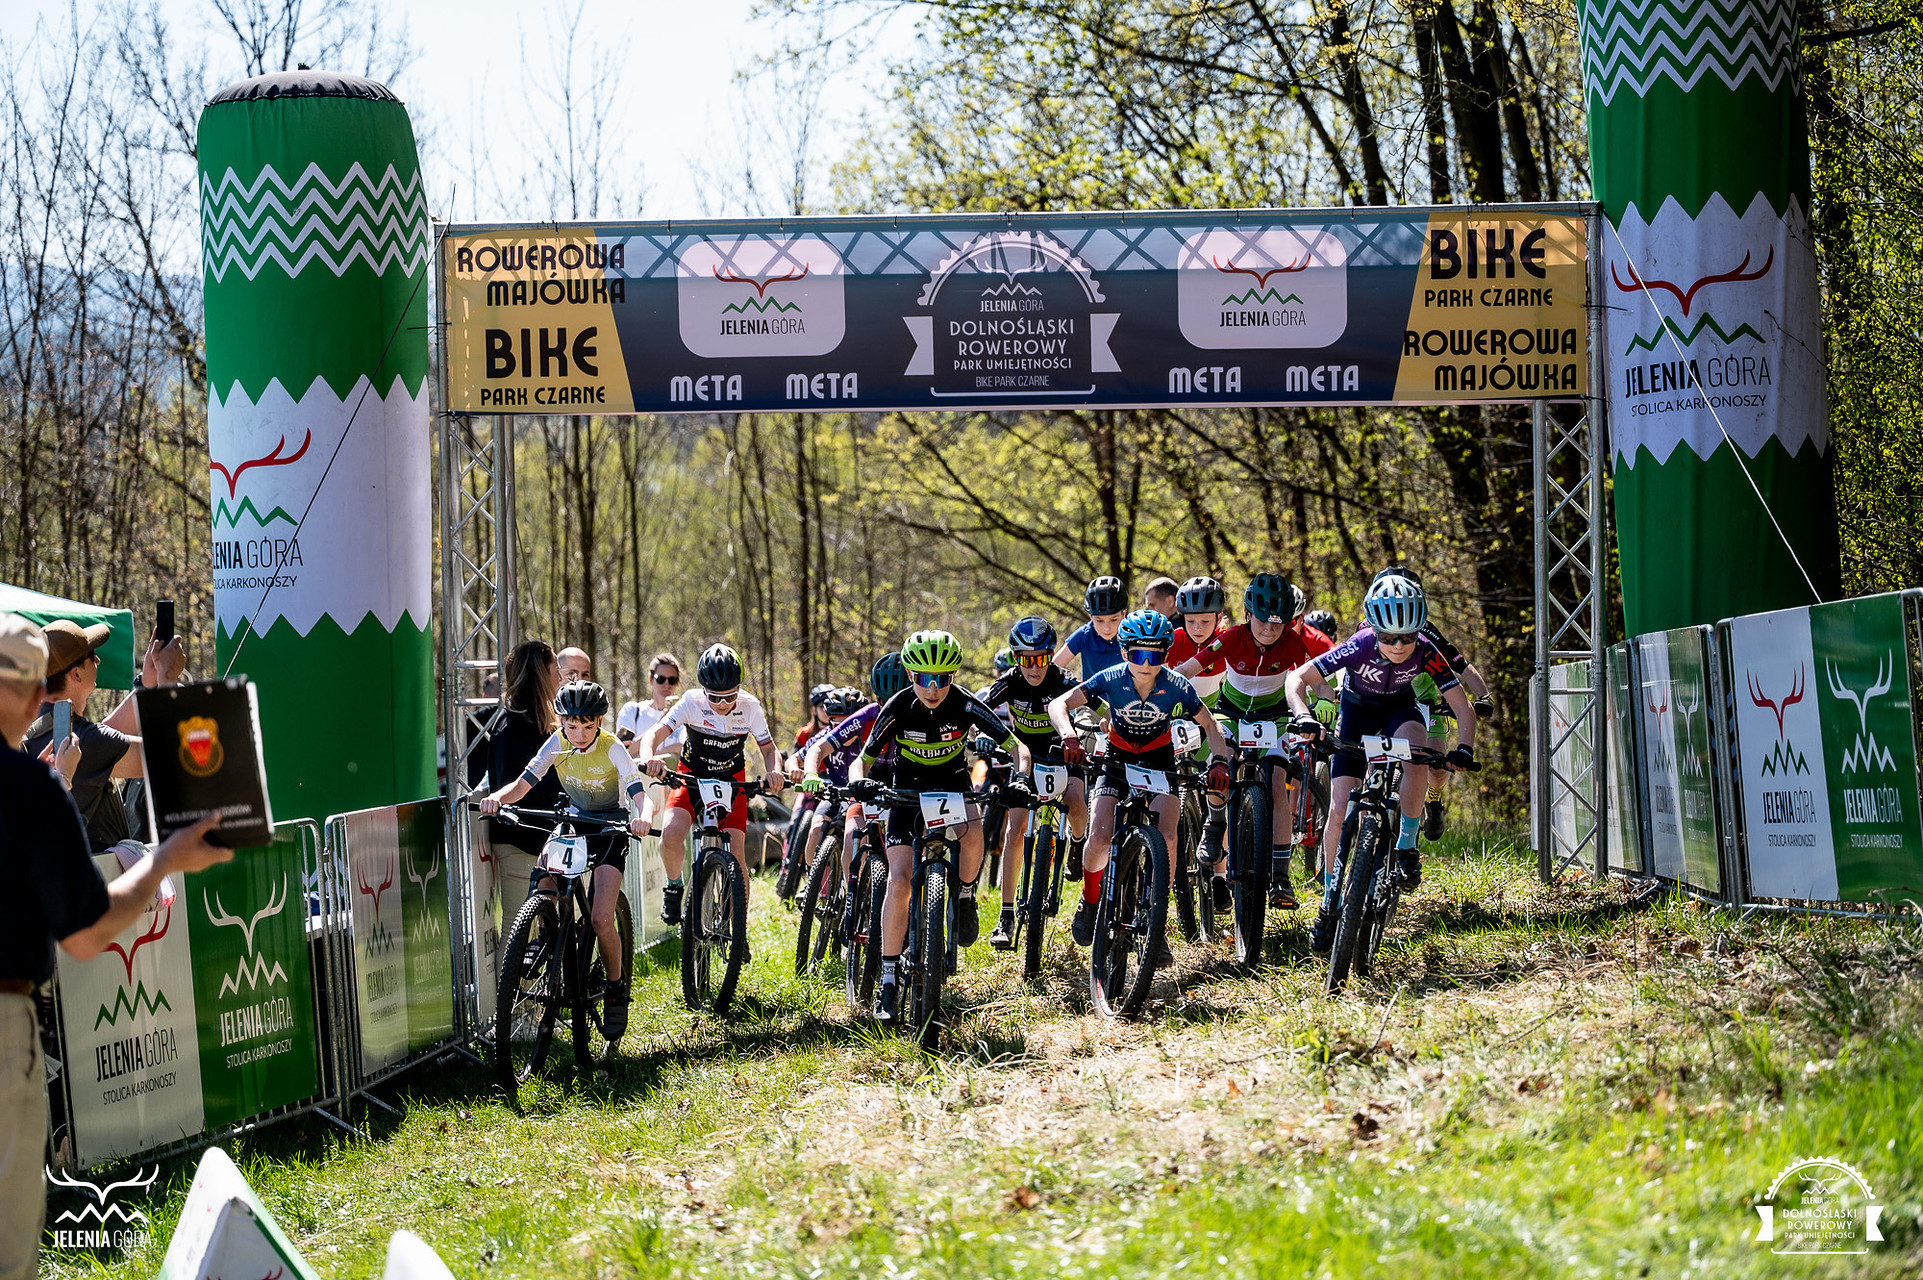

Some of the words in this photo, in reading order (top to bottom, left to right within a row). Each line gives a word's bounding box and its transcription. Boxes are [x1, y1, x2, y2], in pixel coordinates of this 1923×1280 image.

[458, 243, 625, 273] ROWEROWA
[1431, 228, 1546, 280] BIKE
[486, 273, 625, 306] MAJÓWKA
[1425, 289, 1473, 308] PARK
[1480, 288, 1553, 308] CZARNE
[980, 300, 1018, 312] JELENIA
[1018, 298, 1044, 312] GÓRA
[720, 318, 770, 336] JELENIA
[771, 315, 806, 335] GÓRA
[950, 317, 1074, 337] DOLNOŚLĄSKI
[1219, 310, 1270, 327] JELENIA
[1272, 306, 1307, 326] GÓRA
[485, 326, 599, 379] BIKE
[959, 339, 1067, 356] ROWEROWY
[1404, 328, 1577, 357] ROWEROWA
[954, 359, 983, 370] PARK
[986, 357, 1072, 371] UMIEJĘTNOŚCI
[1434, 358, 1577, 392] MAJÓWKA
[786, 372, 859, 399] META
[975, 376, 993, 388] BIKE
[994, 376, 1017, 387] PARK
[1018, 375, 1050, 387] CZARNE
[1169, 366, 1242, 393] META
[1286, 364, 1359, 392] META
[1625, 359, 1703, 398] JELENIA
[1707, 354, 1771, 388] GÓRA
[480, 387, 529, 406] PARK
[534, 385, 606, 406] CZARNE
[670, 375, 743, 402] META
[1632, 401, 1674, 417] STOLICA
[1677, 395, 1767, 412] KARKONOSZY
[247, 535, 303, 569] GÓRA
[226, 576, 298, 590] KARKONOSZY
[1326, 640, 1359, 665] quest
[839, 718, 862, 738] quest
[1177, 726, 1188, 744] 9
[1253, 724, 1263, 738] 3
[1045, 775, 1054, 793] 8
[1142, 774, 1152, 785] 1
[713, 784, 722, 798] 6
[937, 798, 950, 815] 2
[1763, 791, 1795, 824] JELENIA
[1794, 786, 1817, 823] GÓRA
[1844, 788, 1879, 824] JELENIA
[1877, 783, 1903, 823] GÓRA
[1768, 834, 1788, 847] STOLICA
[562, 847, 573, 868] 4
[220, 1004, 263, 1047] JELENIA
[263, 996, 294, 1034] GÓRA
[96, 1036, 144, 1083] JELENIA
[144, 1027, 178, 1067] GÓRA
[226, 1050, 252, 1069] STOLICA
[252, 1038, 292, 1061] KARKONOSZY
[103, 1085, 131, 1106] STOLICA
[131, 1071, 177, 1097] KARKONOSZY
